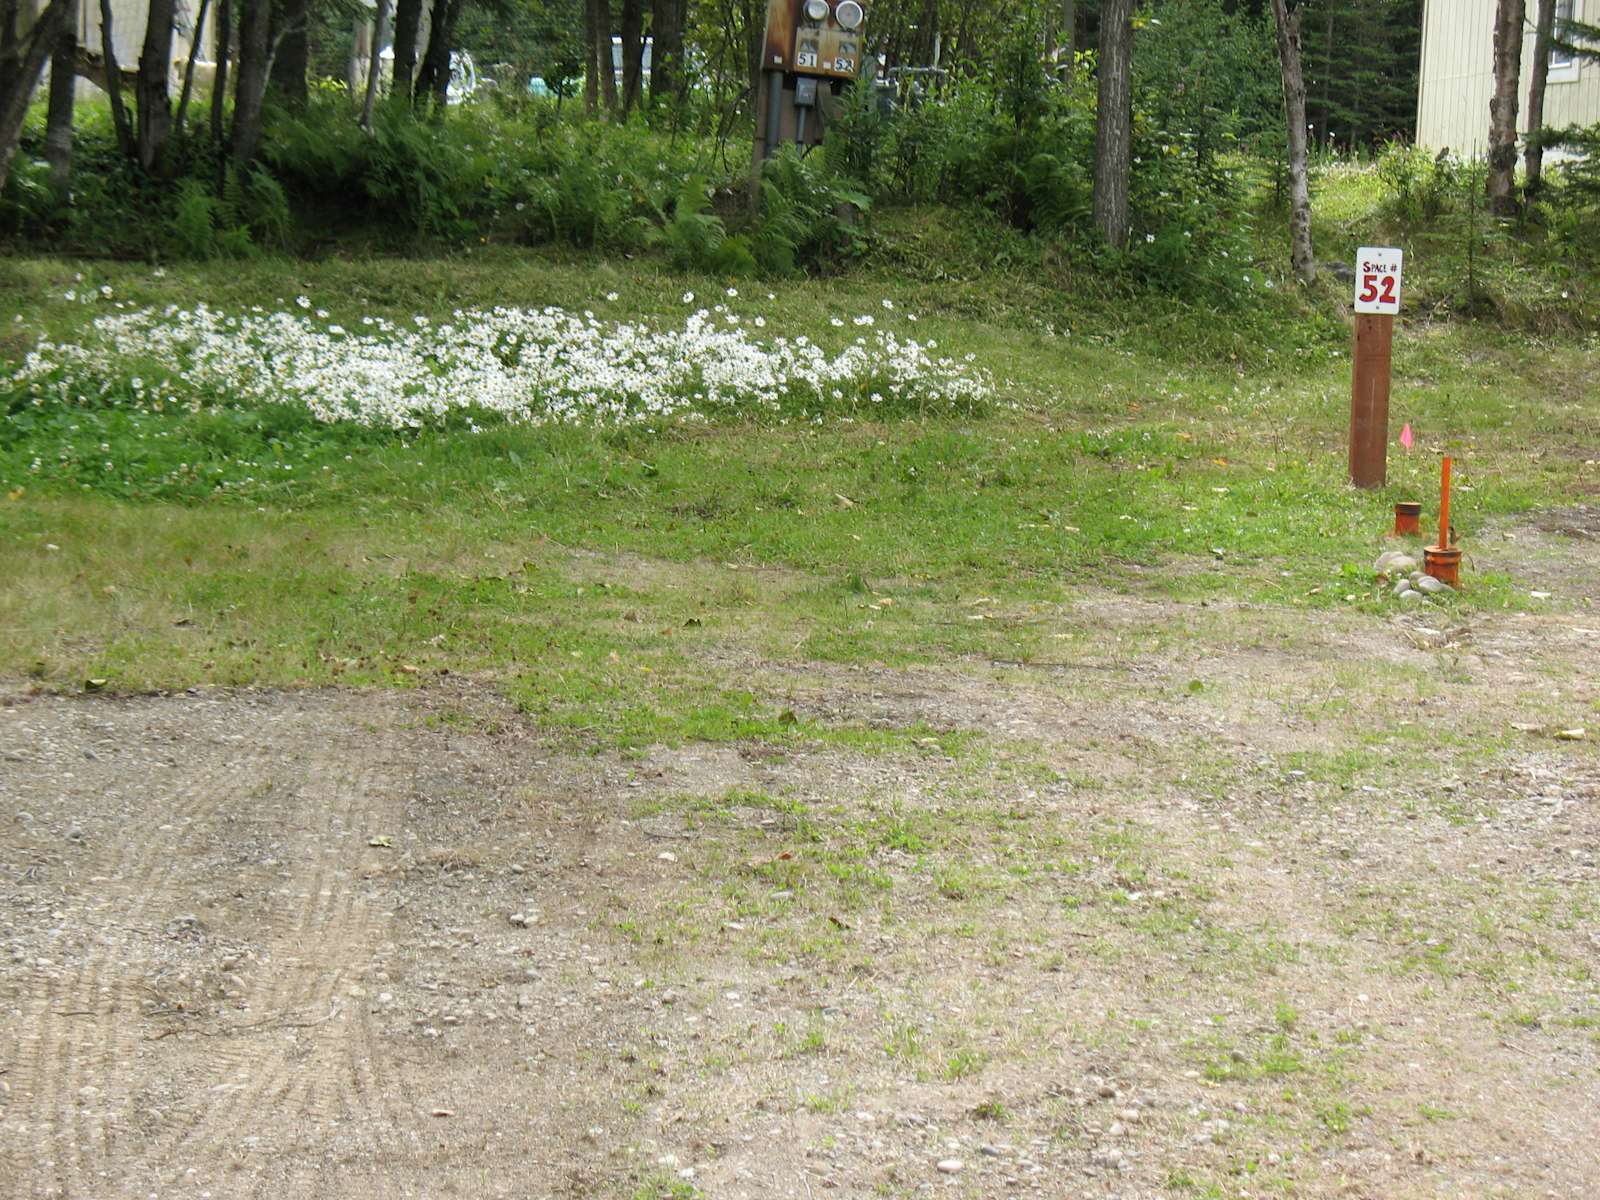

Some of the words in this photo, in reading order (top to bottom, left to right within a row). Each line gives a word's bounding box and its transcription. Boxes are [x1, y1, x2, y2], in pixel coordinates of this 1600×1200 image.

[798, 53, 815, 67] 51
[1363, 261, 1387, 273] SPACE
[1359, 274, 1396, 304] 52
